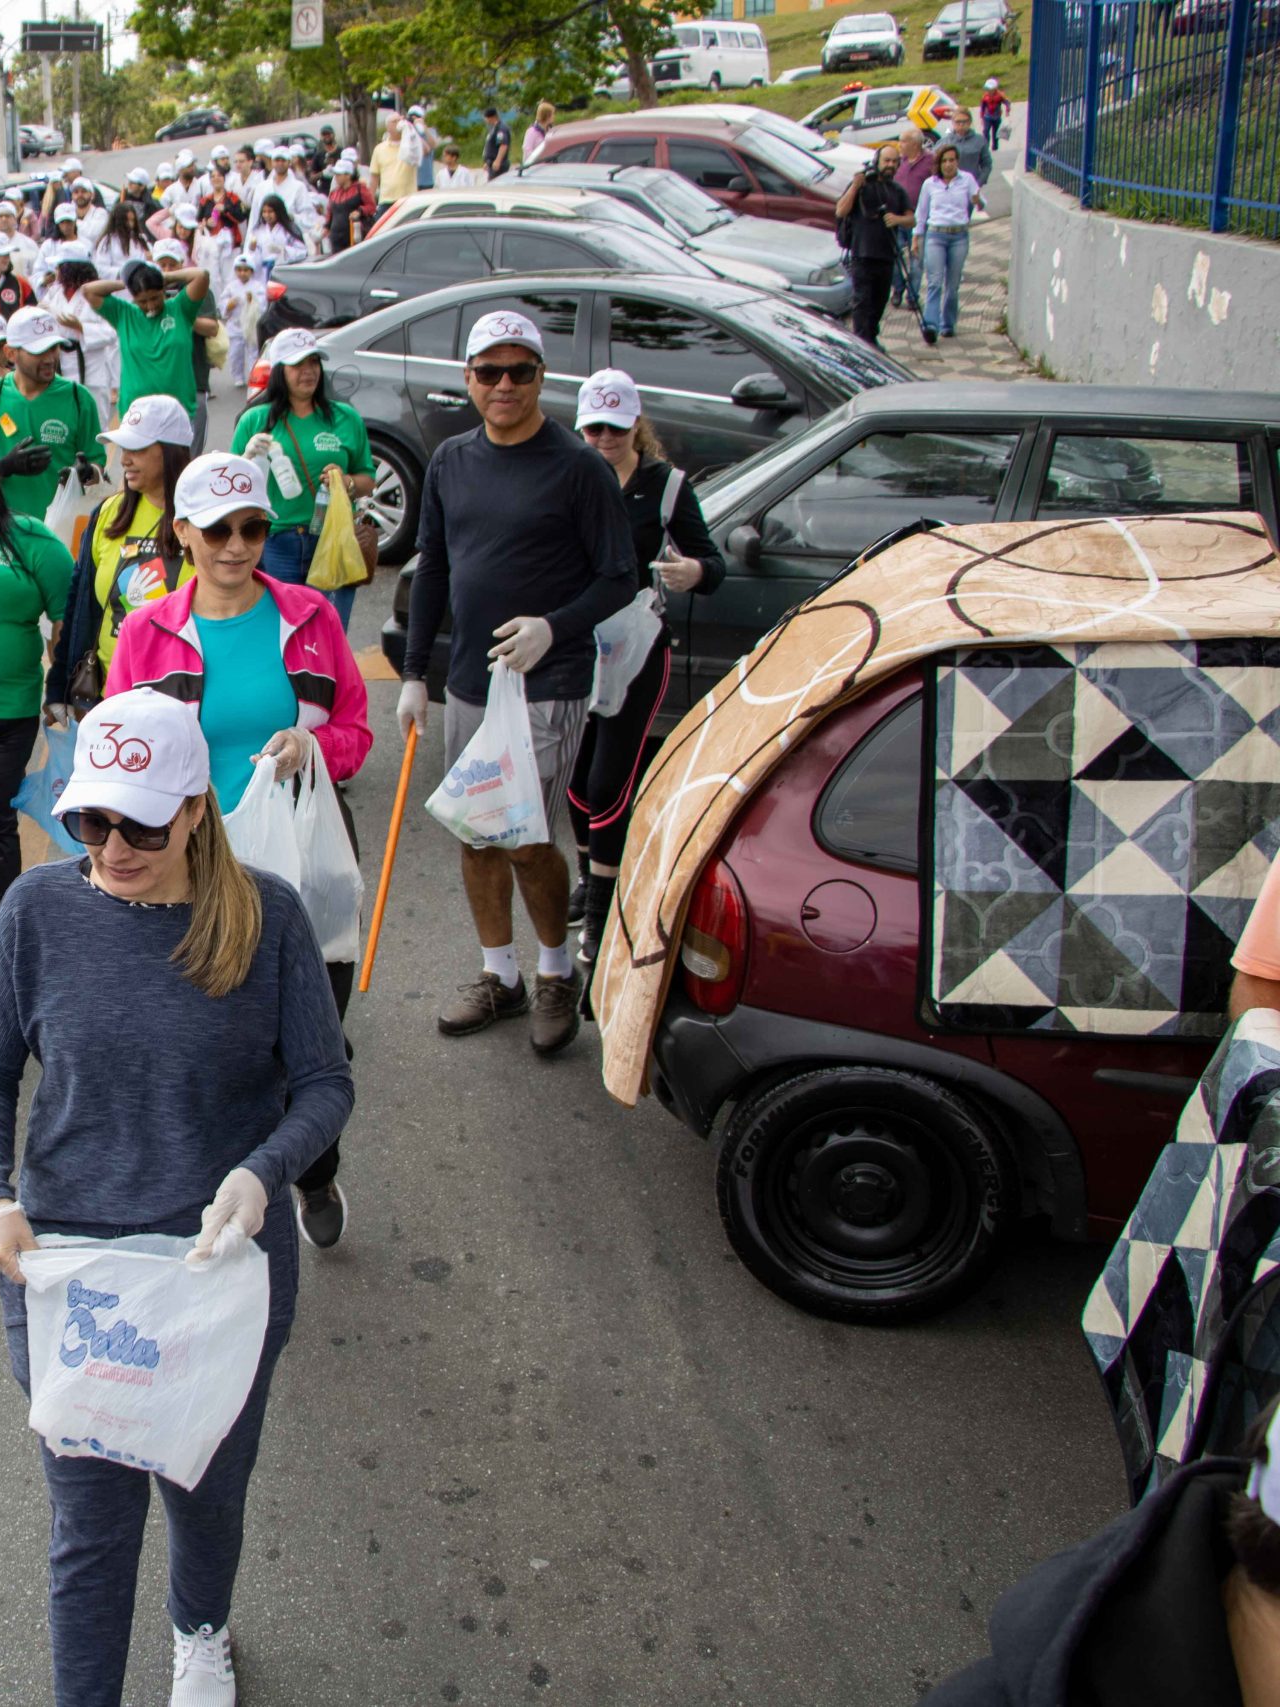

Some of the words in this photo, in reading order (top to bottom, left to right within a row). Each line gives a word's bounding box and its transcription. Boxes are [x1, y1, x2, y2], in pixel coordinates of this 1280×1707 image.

[590, 387, 621, 409] 30
[210, 466, 252, 497] 30
[89, 723, 151, 773] 30
